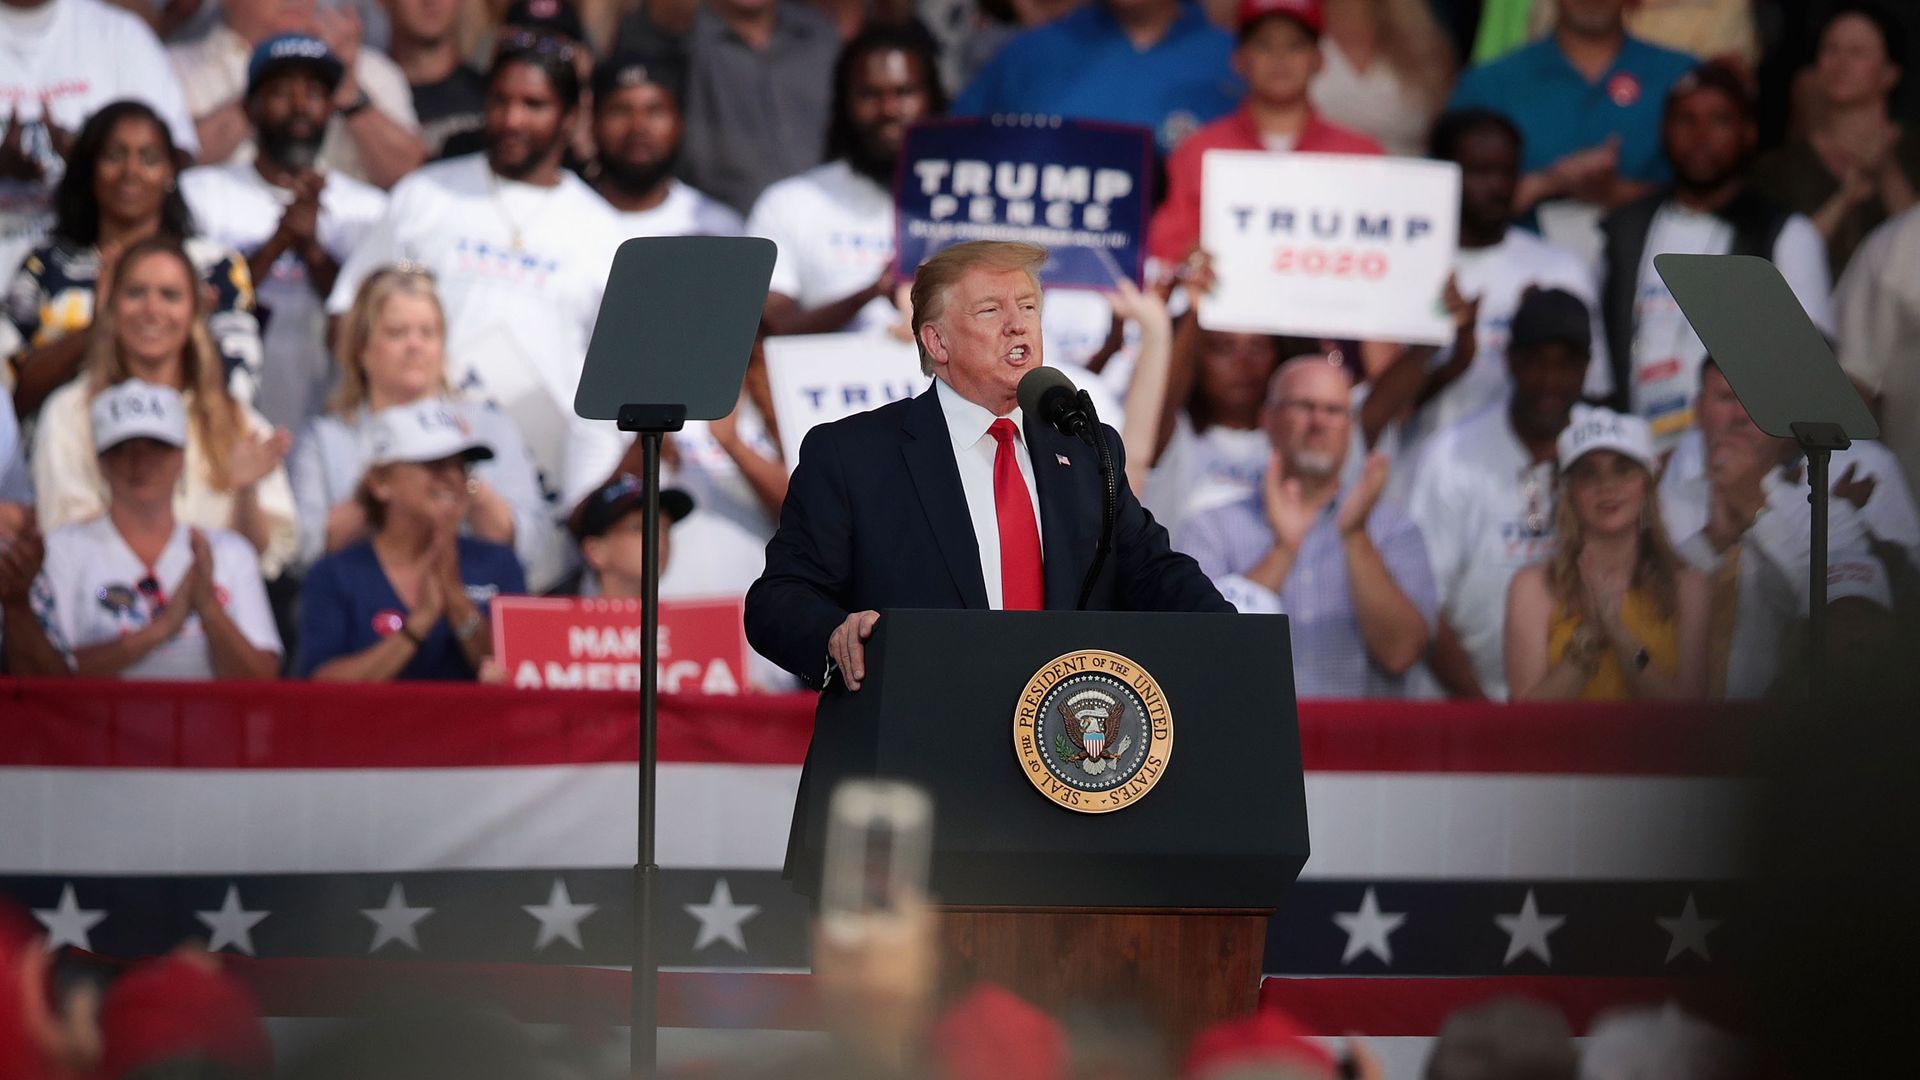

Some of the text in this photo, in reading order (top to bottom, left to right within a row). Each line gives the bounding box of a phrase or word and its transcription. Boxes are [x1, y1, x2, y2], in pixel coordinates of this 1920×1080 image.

[914, 159, 1133, 205] TRUMP
[930, 194, 1111, 231] PENCE
[1232, 206, 1432, 242] TRUMP
[1272, 246, 1390, 281] 2020
[801, 382, 917, 410] TRU
[568, 625, 672, 659] MAKE
[1019, 656, 1168, 805] SEAL OF THE PRESIDENT OF THE UNITED STATES
